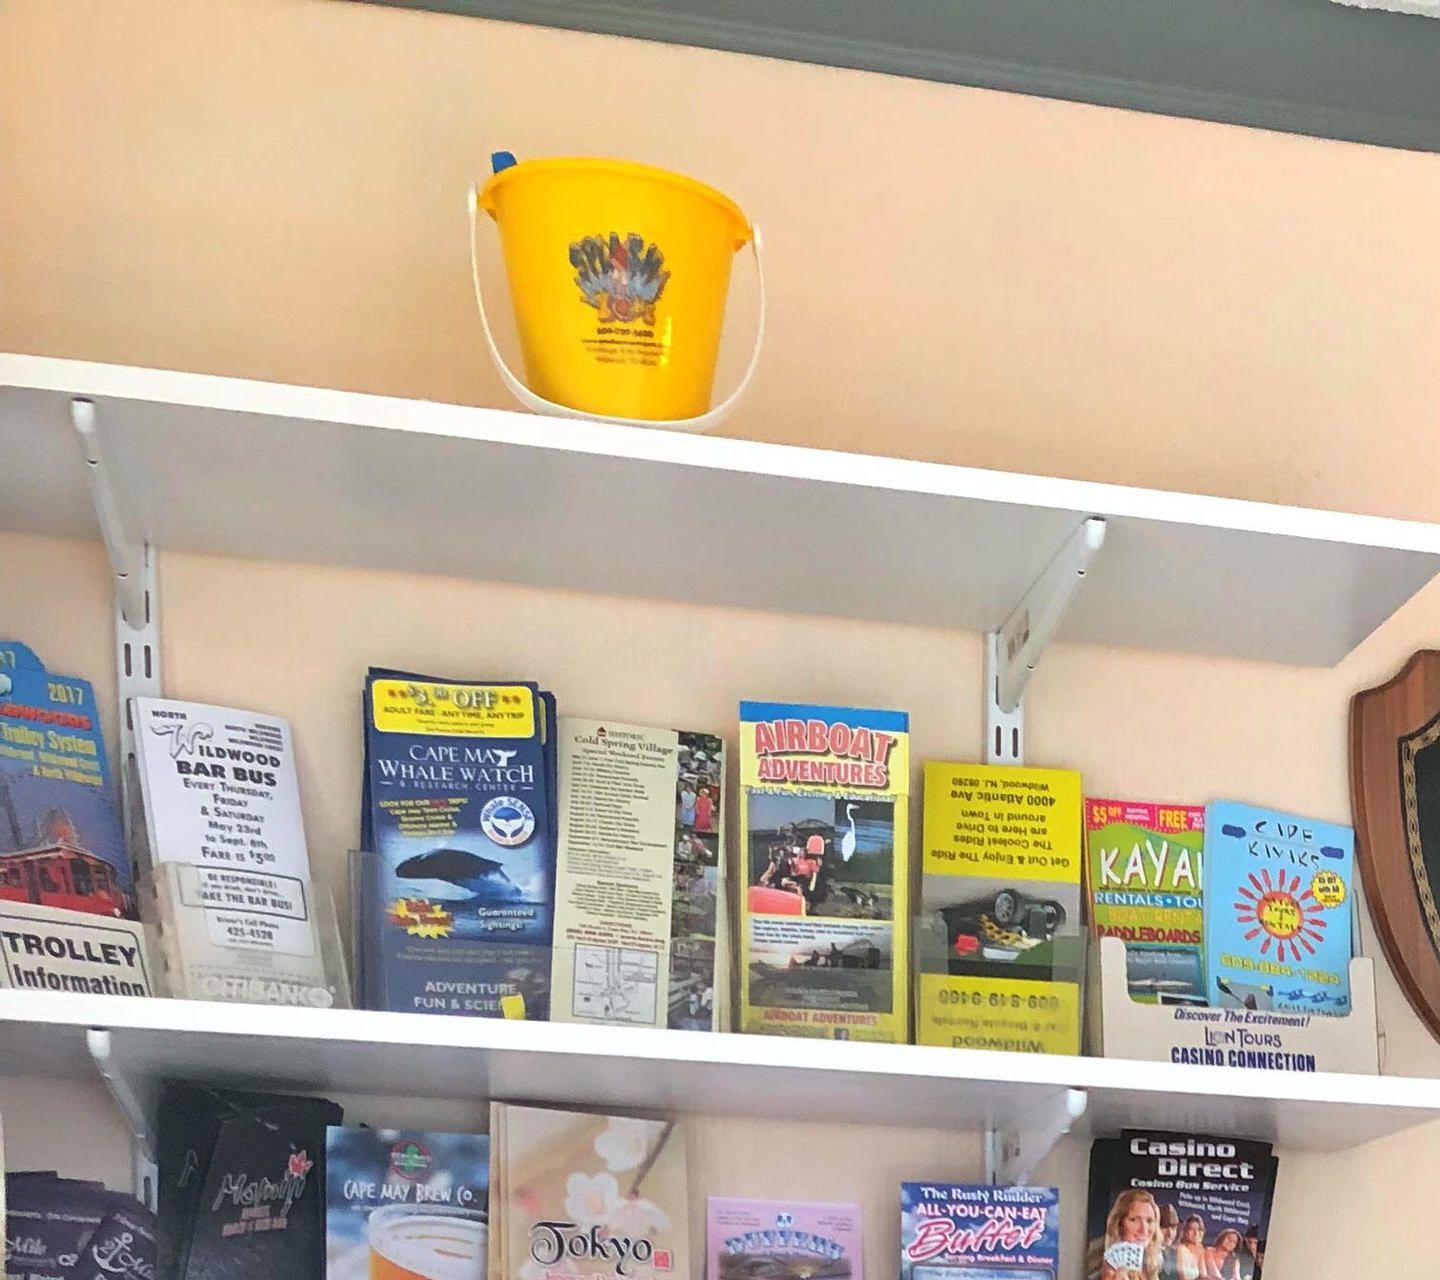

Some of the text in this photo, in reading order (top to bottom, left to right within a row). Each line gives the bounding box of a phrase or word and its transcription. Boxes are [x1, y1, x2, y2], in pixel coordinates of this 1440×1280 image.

[48, 682, 83, 705] 2017
[152, 710, 186, 720] NORTH
[755, 720, 898, 764] AIRBOAT
[177, 761, 277, 787] BAR BUS
[379, 760, 533, 783] WHALE WATCH
[757, 757, 888, 787] ADVENTURES
[950, 790, 1056, 806] 4000 Atlantic Ave
[1092, 806, 1122, 823] $5 OFF
[1159, 809, 1188, 829] FREE
[931, 849, 1069, 867] Get Out & Enjoy The Ride
[478, 908, 534, 917] Guaranteed
[1099, 926, 1200, 943] PADDLEBOARDS
[2, 931, 136, 967] TROLLEY
[12, 964, 145, 998] Information
[425, 982, 517, 994] ADVENTURE
[1174, 1009, 1310, 1028] Discover The Excitement!
[1171, 1047, 1316, 1072] CASINO CONNECTION
[1130, 1138, 1236, 1159] Casino
[1158, 1157, 1254, 1180] Direct
[344, 1180, 376, 1200] CAPE
[380, 1181, 408, 1201] MAY
[416, 1184, 452, 1202] BREW
[920, 1187, 1043, 1206] The Rusty Rudder
[917, 1203, 1047, 1221] ALL-YOU-CAN-EAT
[531, 1221, 652, 1276] Tokyo
[909, 1218, 1046, 1262] Buffet
